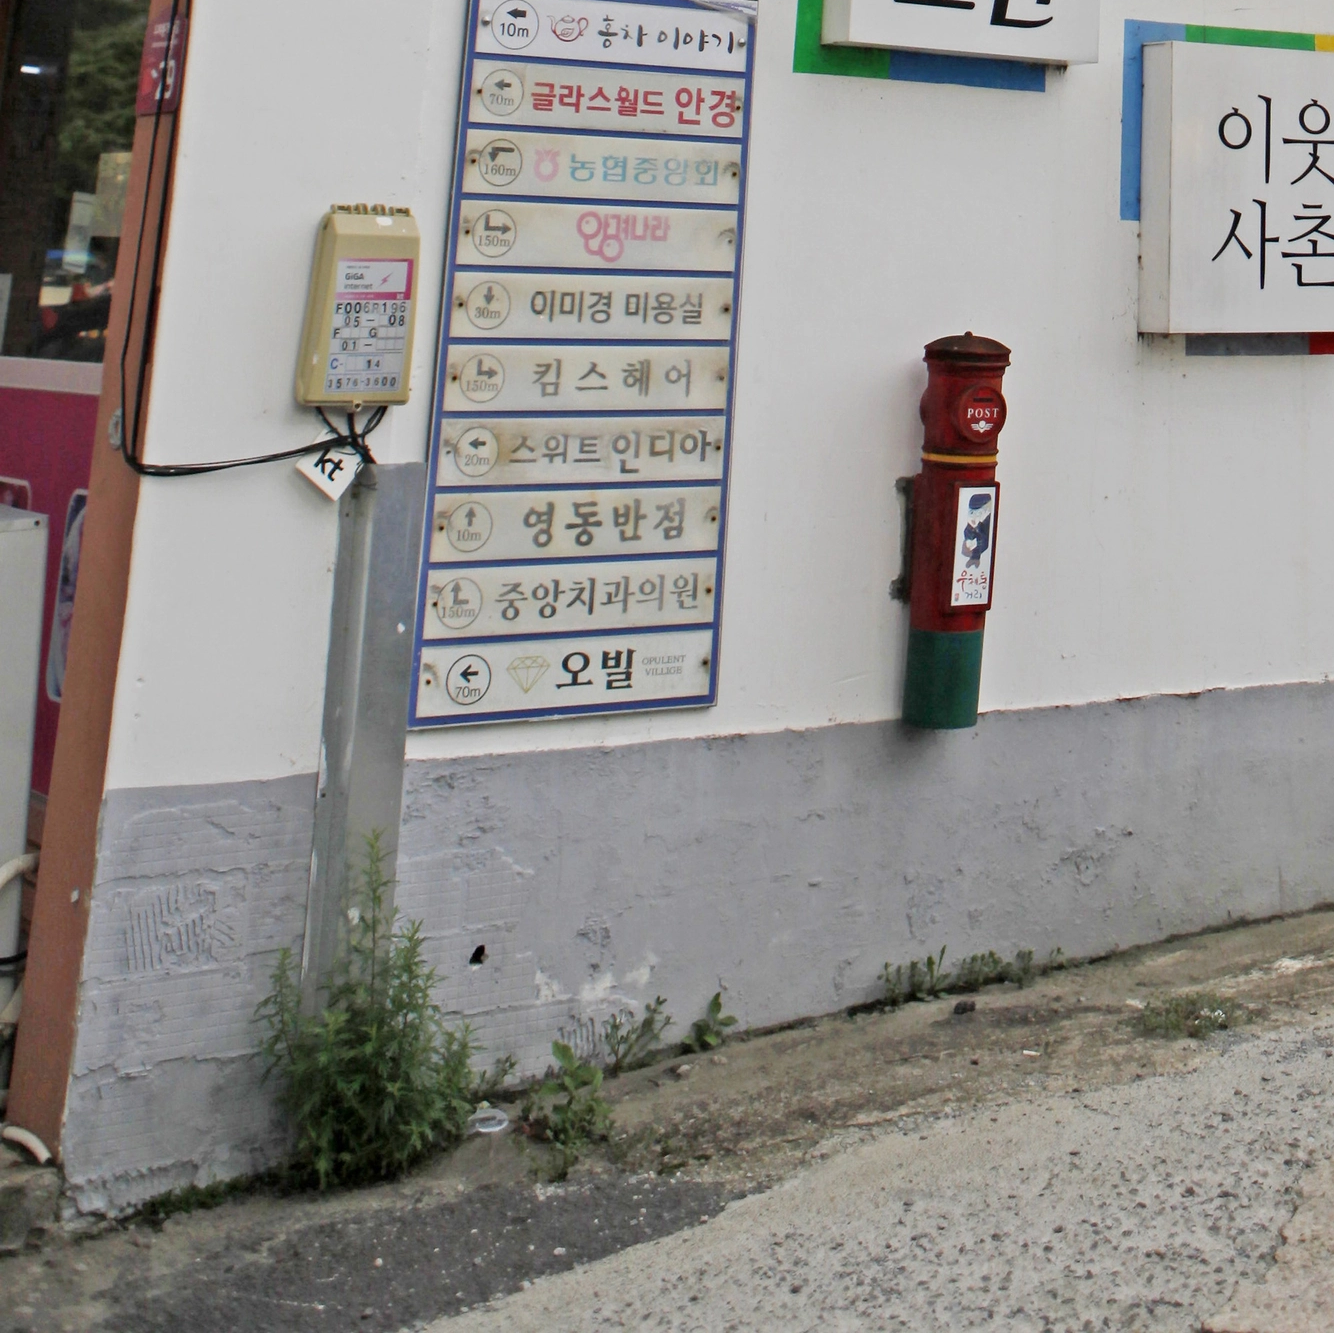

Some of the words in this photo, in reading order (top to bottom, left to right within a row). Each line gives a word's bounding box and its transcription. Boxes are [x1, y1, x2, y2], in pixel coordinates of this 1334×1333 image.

[499, 22, 530, 39] 10m
[597, 14, 648, 49] 홍차
[657, 25, 735, 54] 이야기
[489, 92, 515, 107] 70m
[531, 81, 665, 118] 글라스월드
[675, 86, 737, 129] 안경
[483, 162, 517, 177] 160m
[569, 153, 720, 187] 농협중앙회
[477, 234, 511, 248] 150m
[474, 306, 502, 320] 30m
[530, 290, 613, 324] 이미경
[625, 292, 704, 325] 미용실
[465, 379, 499, 394] 150m
[967, 407, 999, 419] POST
[313, 448, 345, 482] kt
[463, 453, 490, 468] 20m
[456, 529, 482, 542] 10m
[522, 497, 687, 549] 영동반점
[440, 605, 475, 619] 150m
[495, 573, 700, 621] 중앙치과의원
[455, 685, 481, 700] 70m
[555, 648, 637, 690] 오빌
[641, 654, 687, 665] OPULENT
